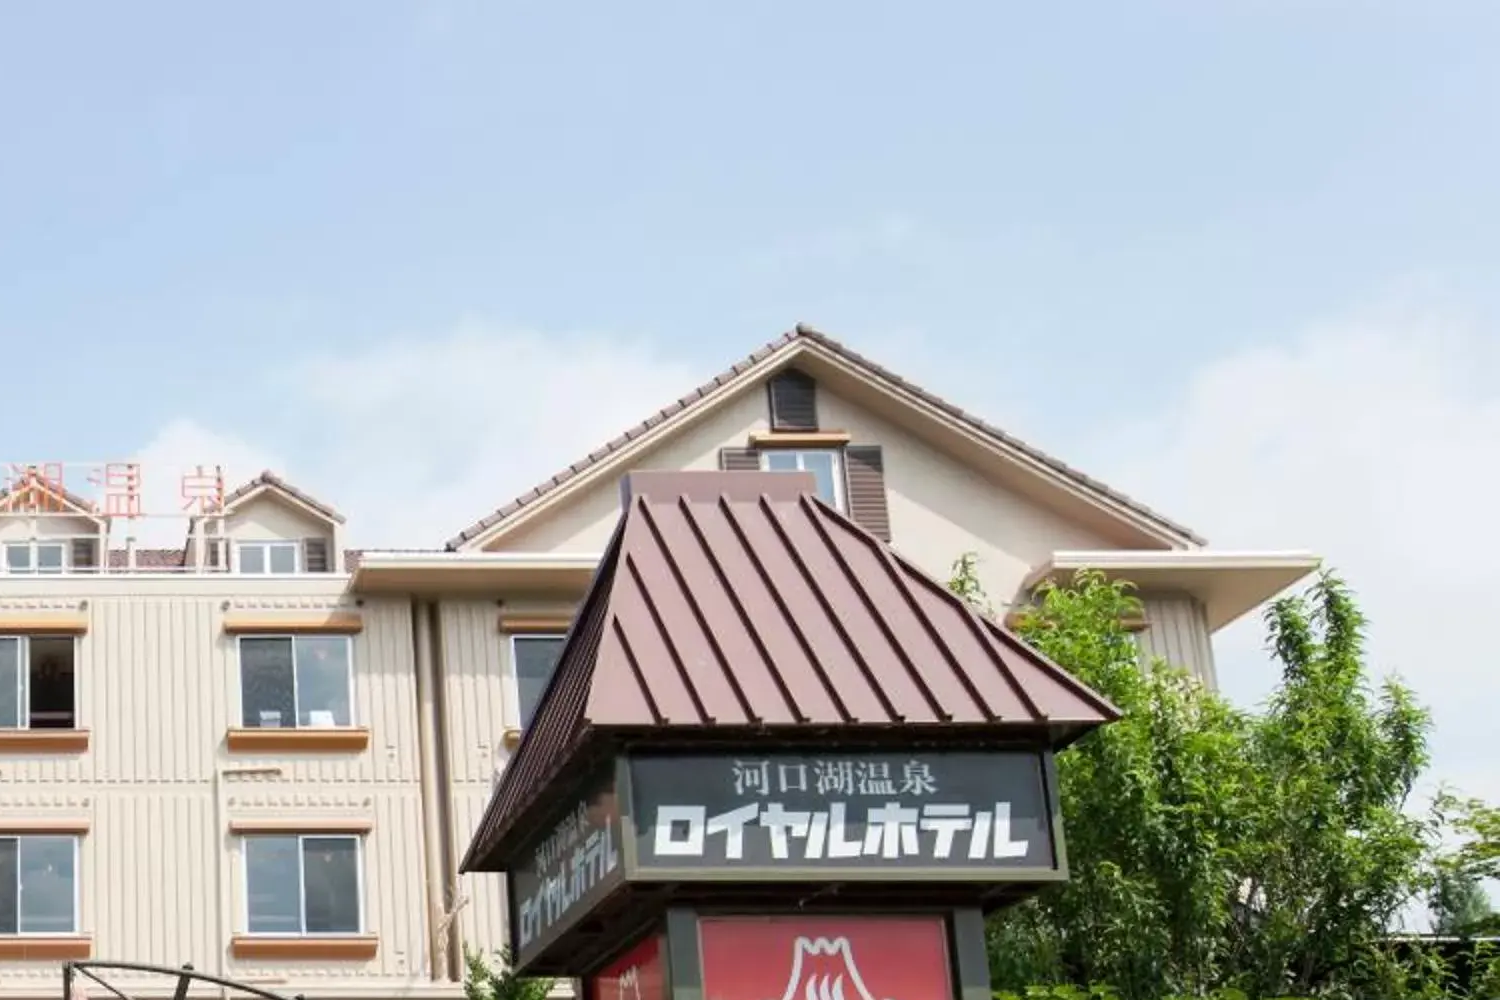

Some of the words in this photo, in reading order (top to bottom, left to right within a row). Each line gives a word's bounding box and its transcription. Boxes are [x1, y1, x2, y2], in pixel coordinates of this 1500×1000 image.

[732, 760, 938, 796] 河口湖温泉
[654, 801, 1029, 859] ロイヤルホテル
[518, 813, 620, 949] ロイヤルホテル
